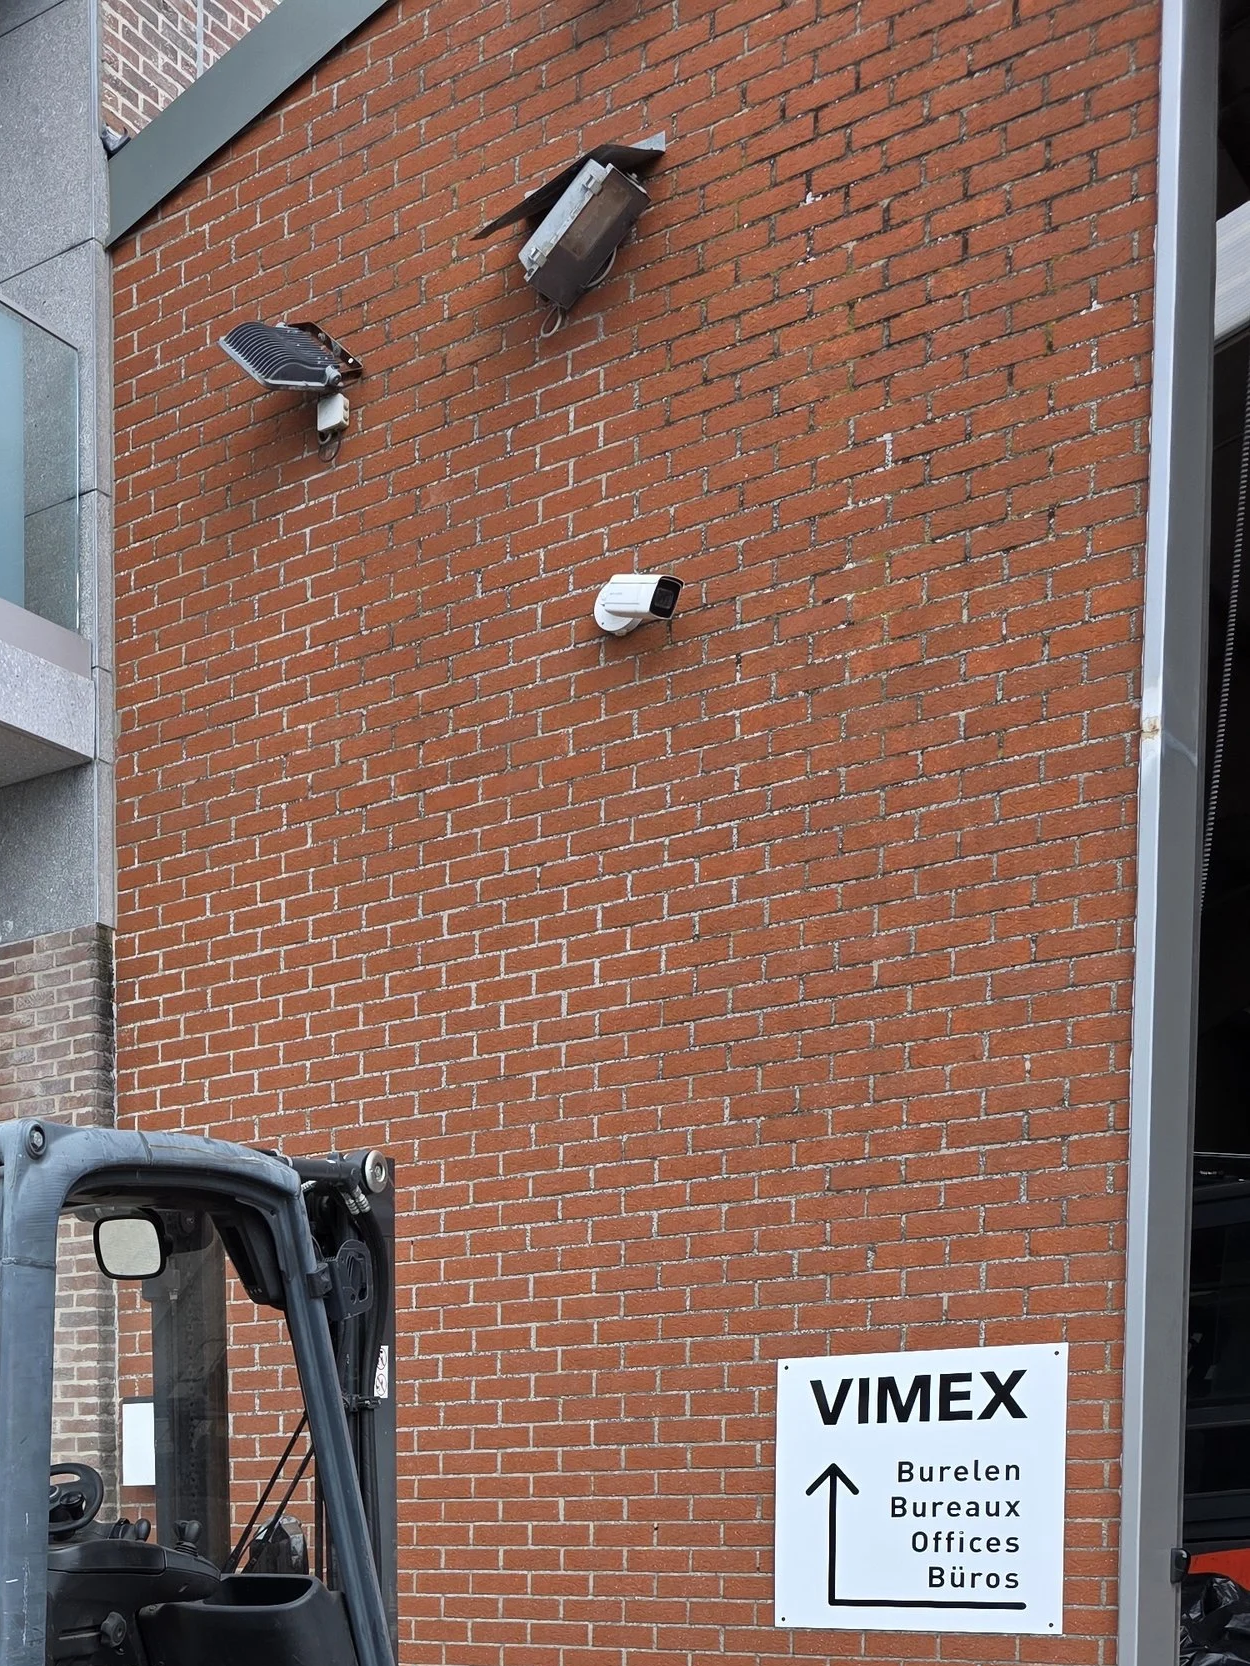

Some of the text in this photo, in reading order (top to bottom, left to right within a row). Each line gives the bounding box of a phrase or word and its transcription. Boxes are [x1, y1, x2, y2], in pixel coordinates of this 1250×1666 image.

[809, 1369, 1028, 1426] VIMEX
[897, 1459, 1020, 1483] Burelen
[890, 1496, 1021, 1518] Bureaux
[911, 1531, 1020, 1553] Offices
[928, 1566, 1020, 1589] Büros
